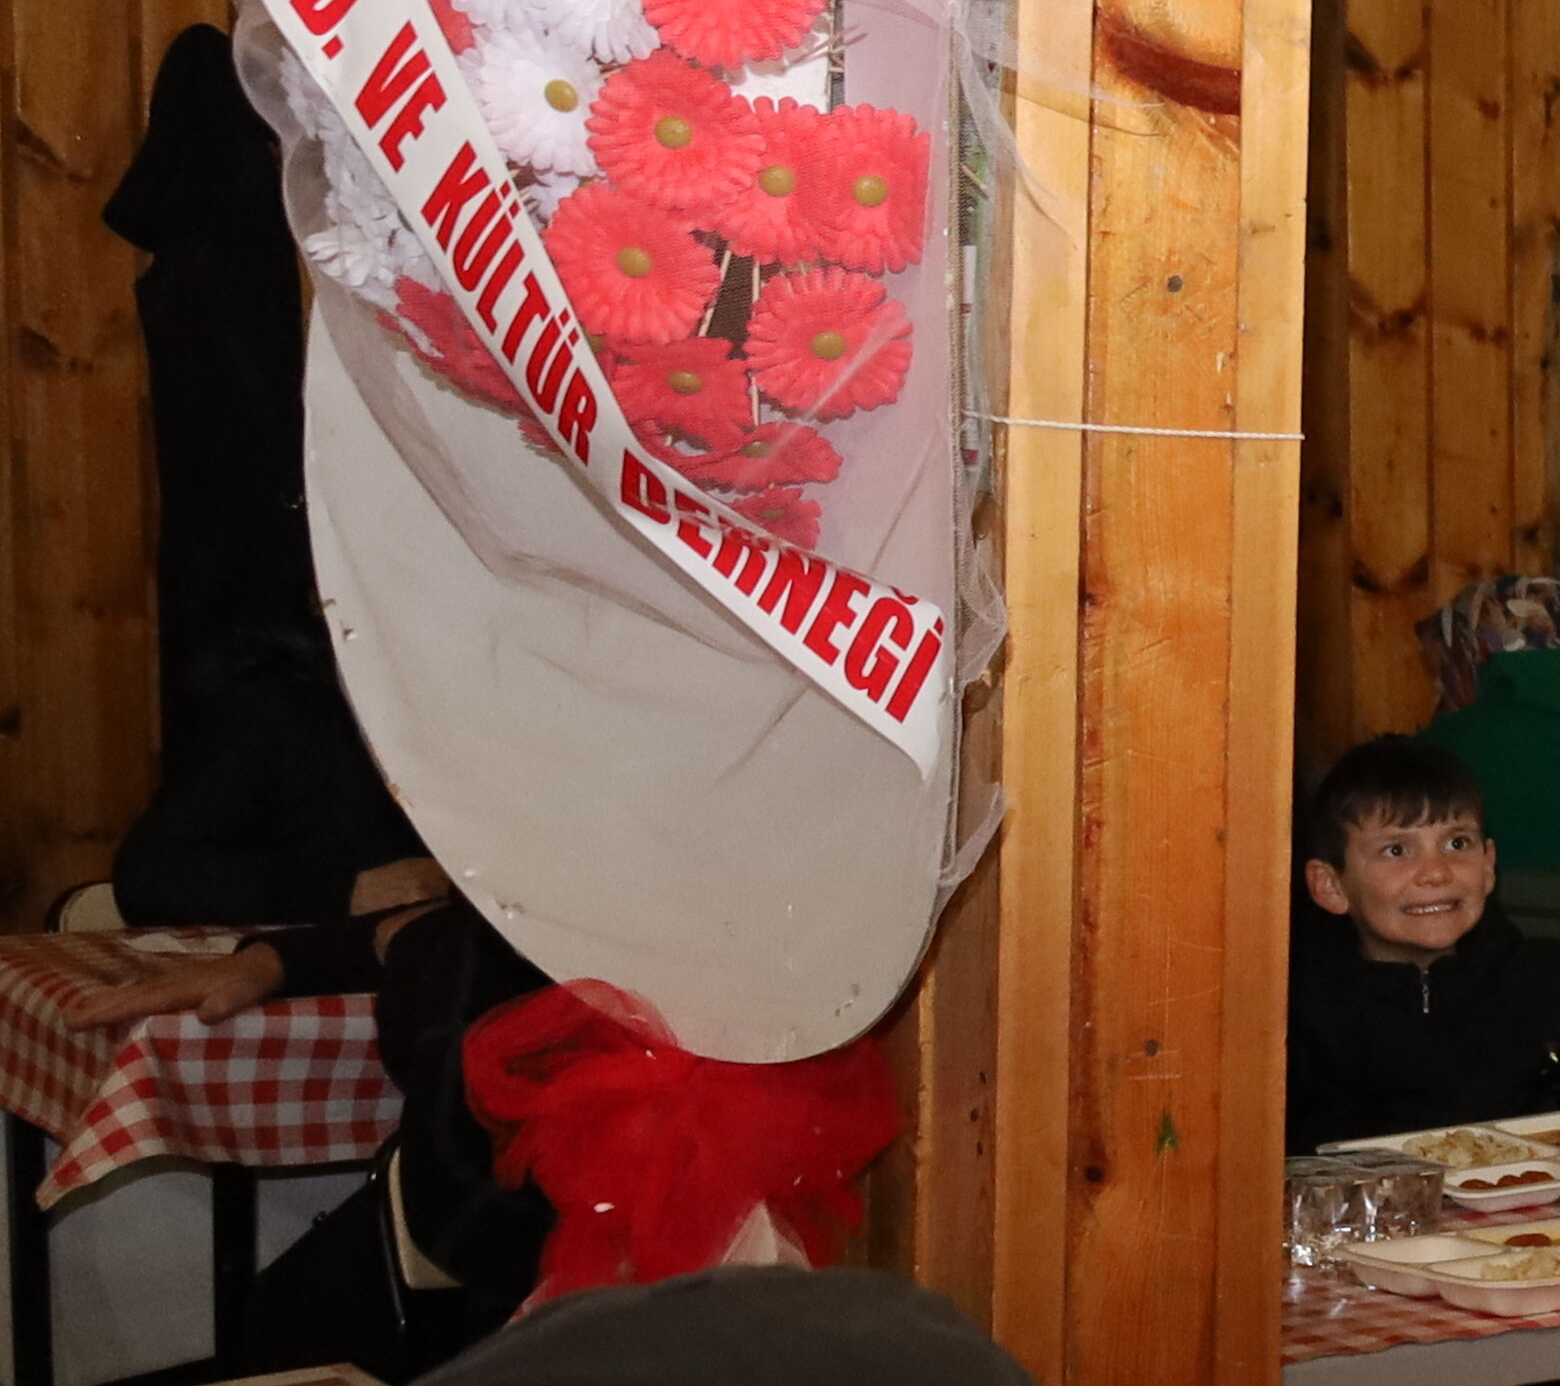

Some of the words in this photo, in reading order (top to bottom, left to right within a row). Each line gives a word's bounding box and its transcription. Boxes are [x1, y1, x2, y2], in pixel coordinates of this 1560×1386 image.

[355, 20, 447, 173] VE
[421, 140, 597, 467] KÜLTÜR
[620, 448, 944, 724] DERNEĞİ
